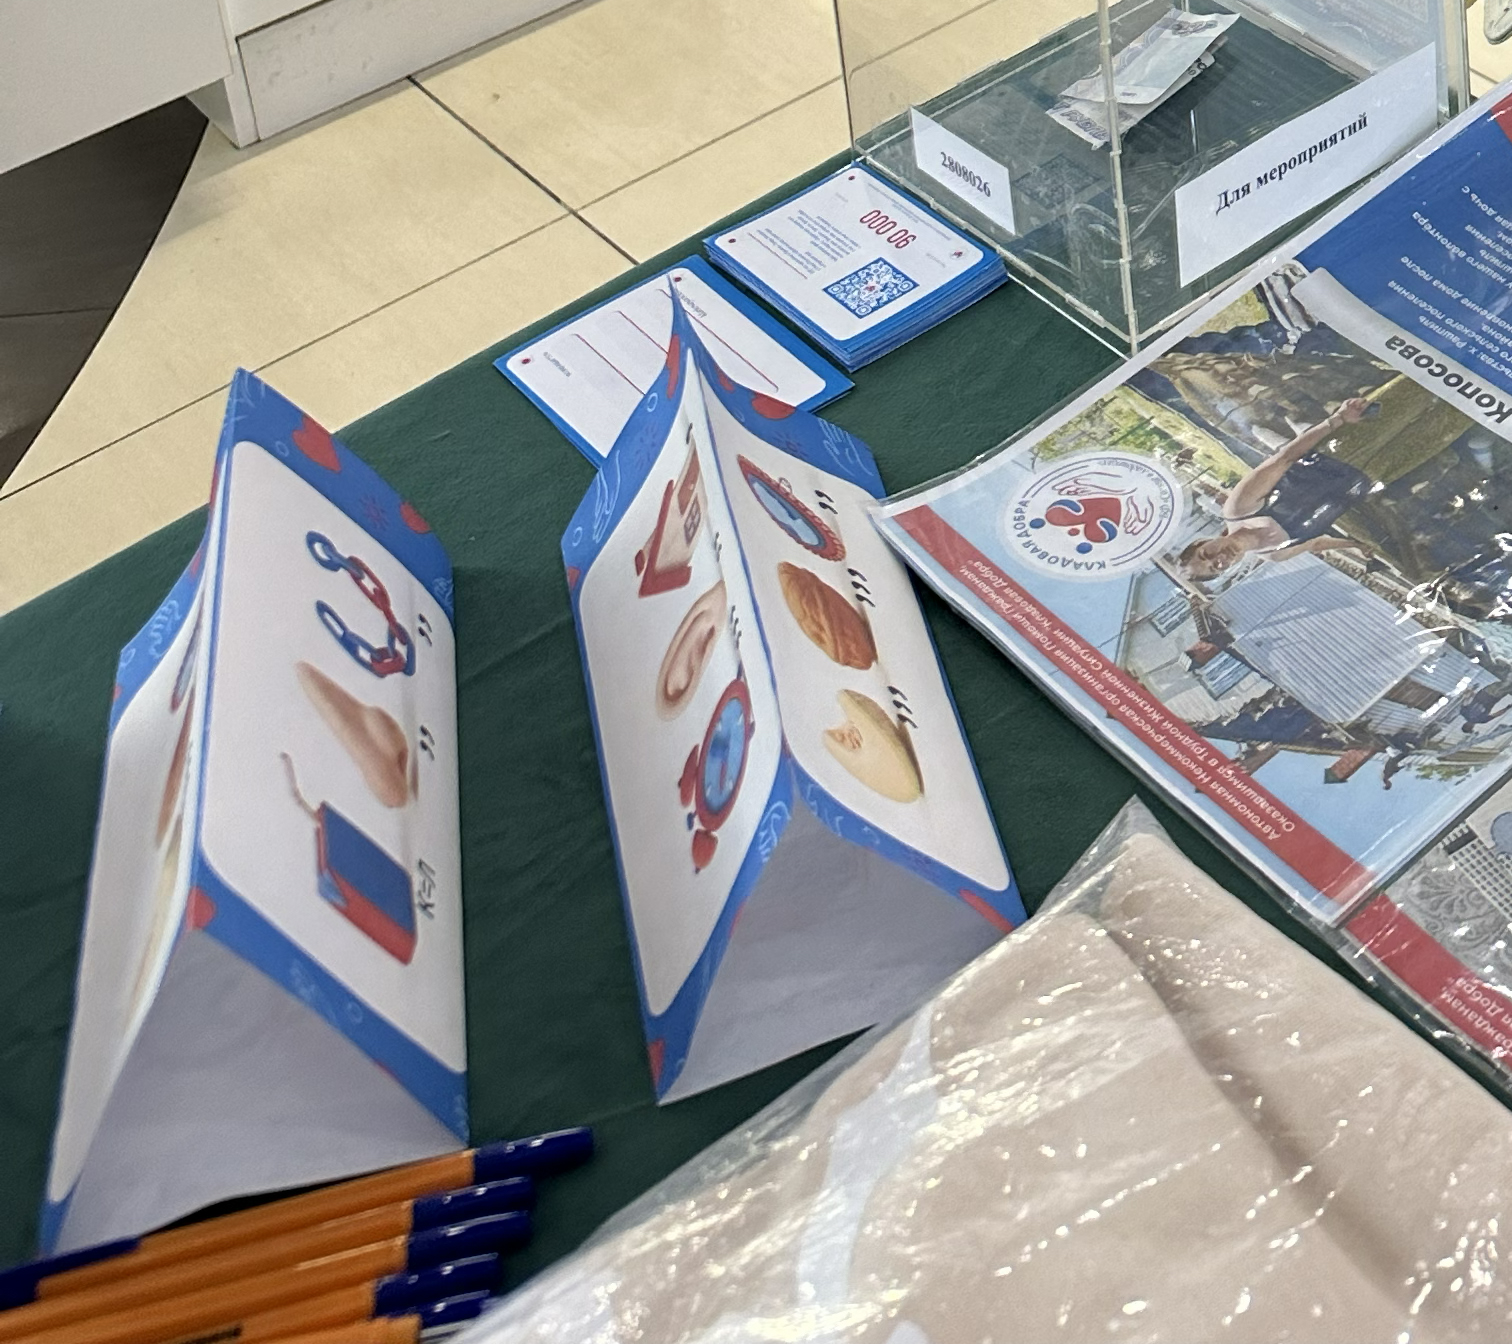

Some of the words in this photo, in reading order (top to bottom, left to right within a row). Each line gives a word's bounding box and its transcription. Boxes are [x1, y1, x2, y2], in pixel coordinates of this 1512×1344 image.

[938, 150, 993, 199] 2808026
[1213, 182, 1255, 217] Для
[1254, 110, 1371, 191] мероприятий
[859, 209, 897, 235] 000
[887, 228, 917, 250] 90
[1409, 211, 1468, 258] волонтёра
[1465, 255, 1507, 283] нашего
[1386, 280, 1446, 318] поселения
[1414, 314, 1467, 348] Рашпиль
[1444, 316, 1501, 352] сельского
[1464, 345, 1478, 354] х.
[1013, 501, 1032, 538] ДОБРА
[1021, 540, 1103, 573] КЛАДОВАЯ
